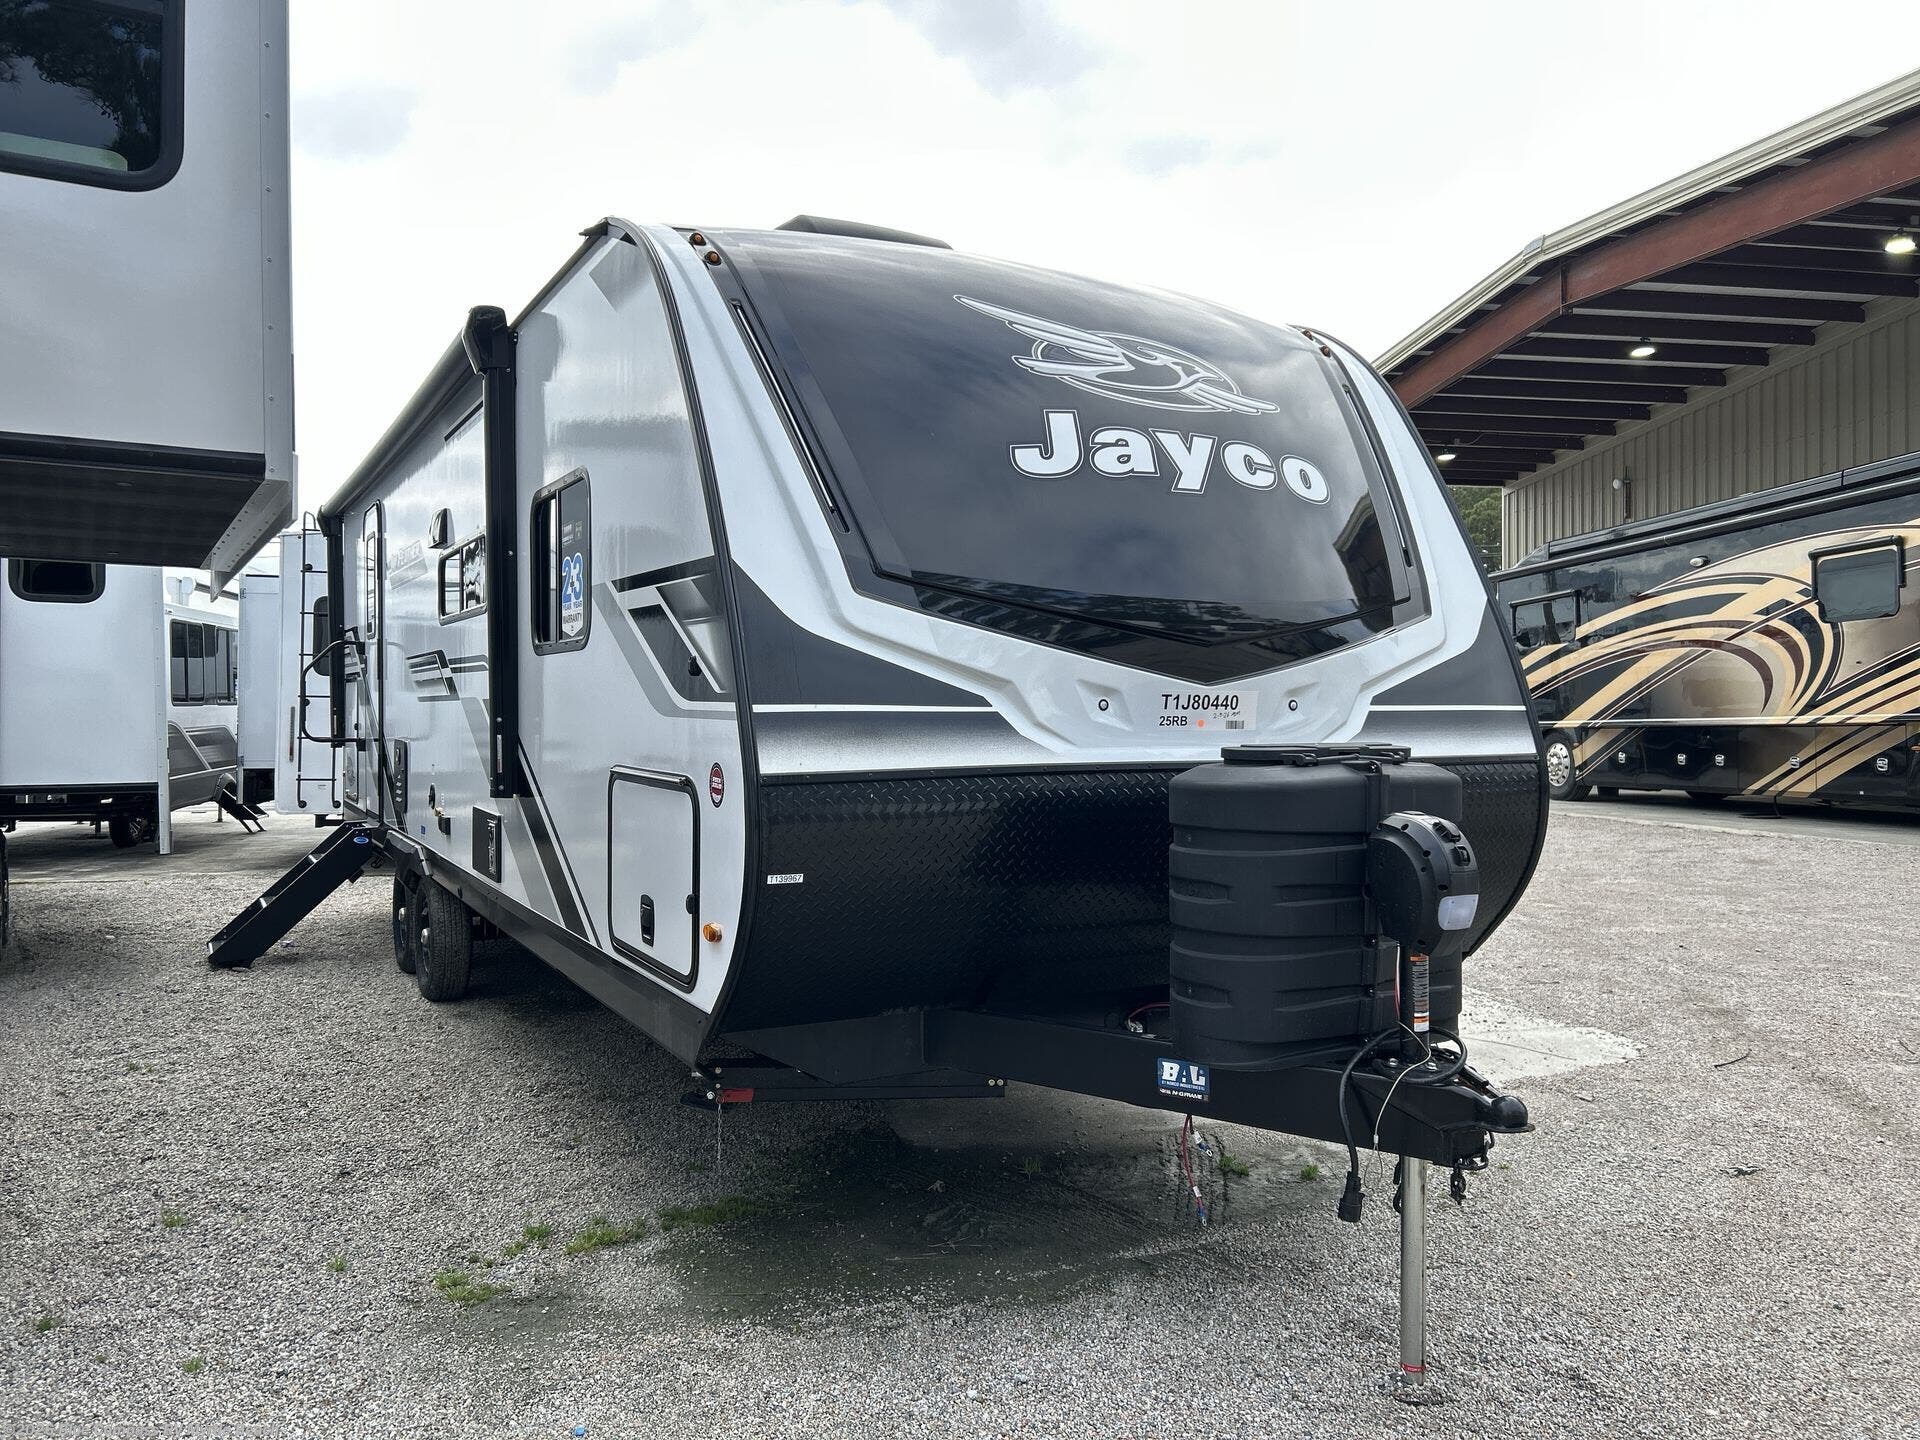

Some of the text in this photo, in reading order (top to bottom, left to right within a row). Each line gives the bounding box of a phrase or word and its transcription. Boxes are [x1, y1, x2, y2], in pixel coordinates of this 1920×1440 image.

[1010, 410, 1331, 504] Jayco
[563, 612, 583, 625] WARRANTY
[1161, 694, 1239, 710] T1J80440
[1159, 716, 1188, 726] 25RB
[1161, 1061, 1206, 1086] BAL
